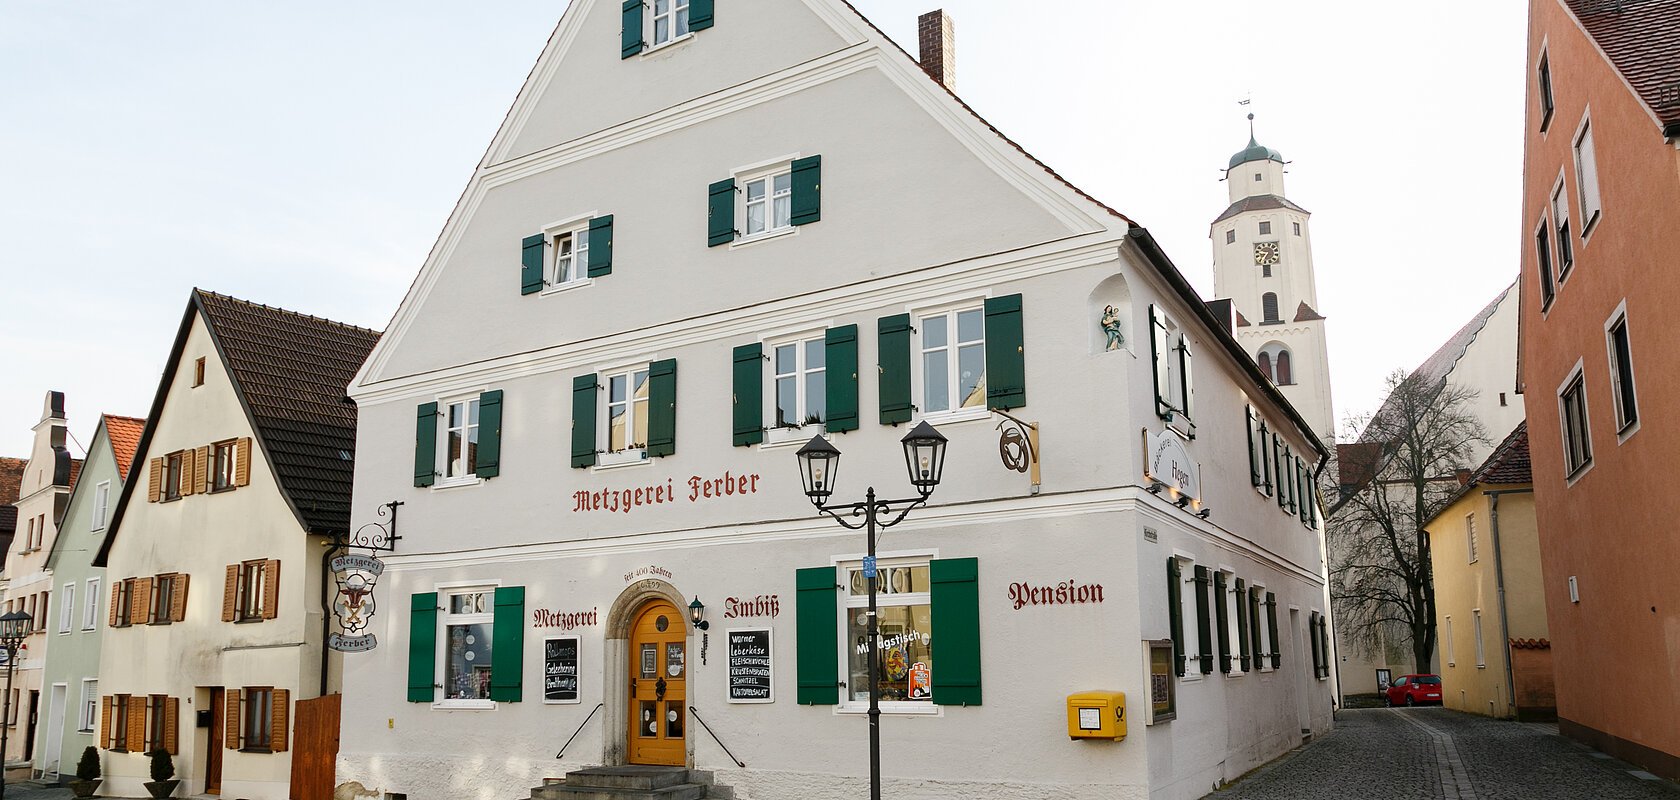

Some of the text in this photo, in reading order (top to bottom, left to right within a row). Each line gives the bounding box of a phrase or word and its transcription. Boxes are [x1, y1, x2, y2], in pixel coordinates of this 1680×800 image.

[572, 470, 760, 513] Metzgerei Ferber
[334, 557, 380, 570] Metzgerei
[649, 565, 673, 579] Jahren
[723, 594, 779, 620] Imbiß
[1007, 579, 1104, 610] Pension
[532, 606, 598, 631] Metzgerei
[334, 637, 370, 648] Ferber
[856, 630, 920, 655] Miagstisch
